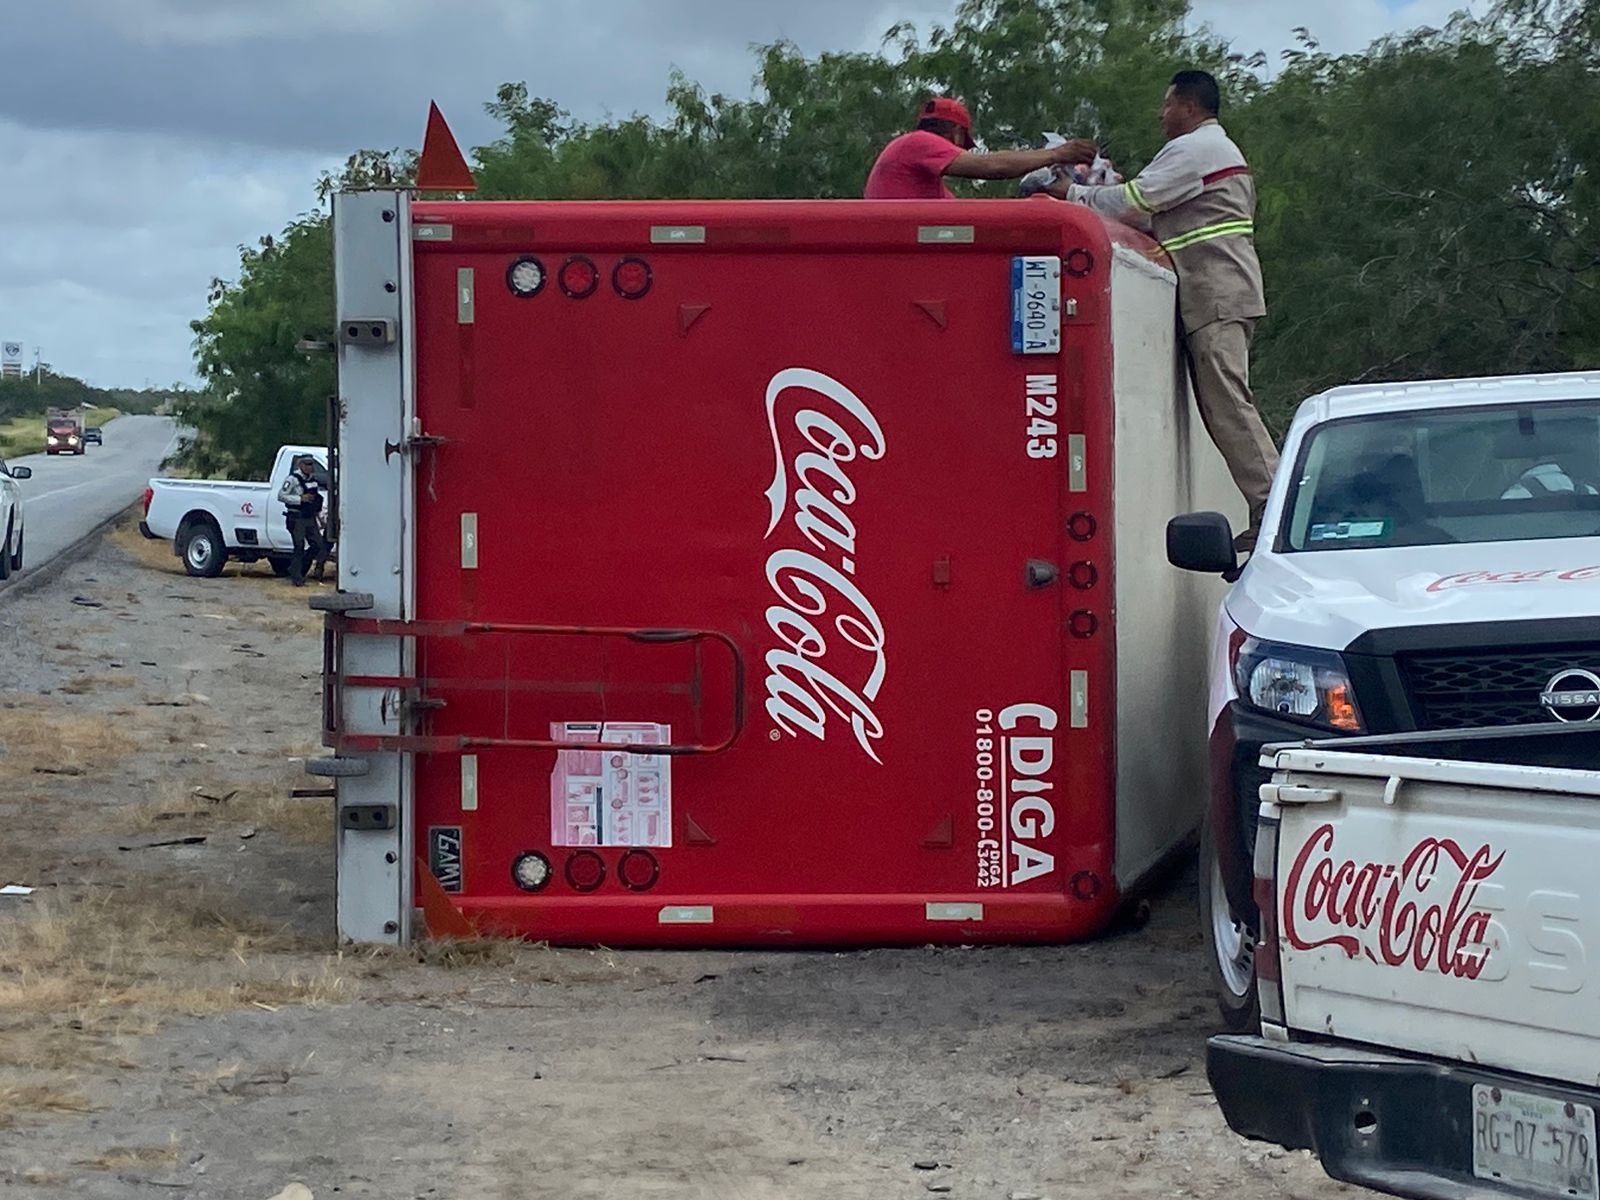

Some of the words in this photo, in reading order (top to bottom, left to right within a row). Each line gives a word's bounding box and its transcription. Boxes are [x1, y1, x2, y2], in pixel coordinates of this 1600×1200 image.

[1026, 374, 1058, 459] M243
[764, 367, 886, 766] Coca-Cola
[1541, 693, 1600, 706] NISSA
[1283, 823, 1507, 980] Coca-Cola
